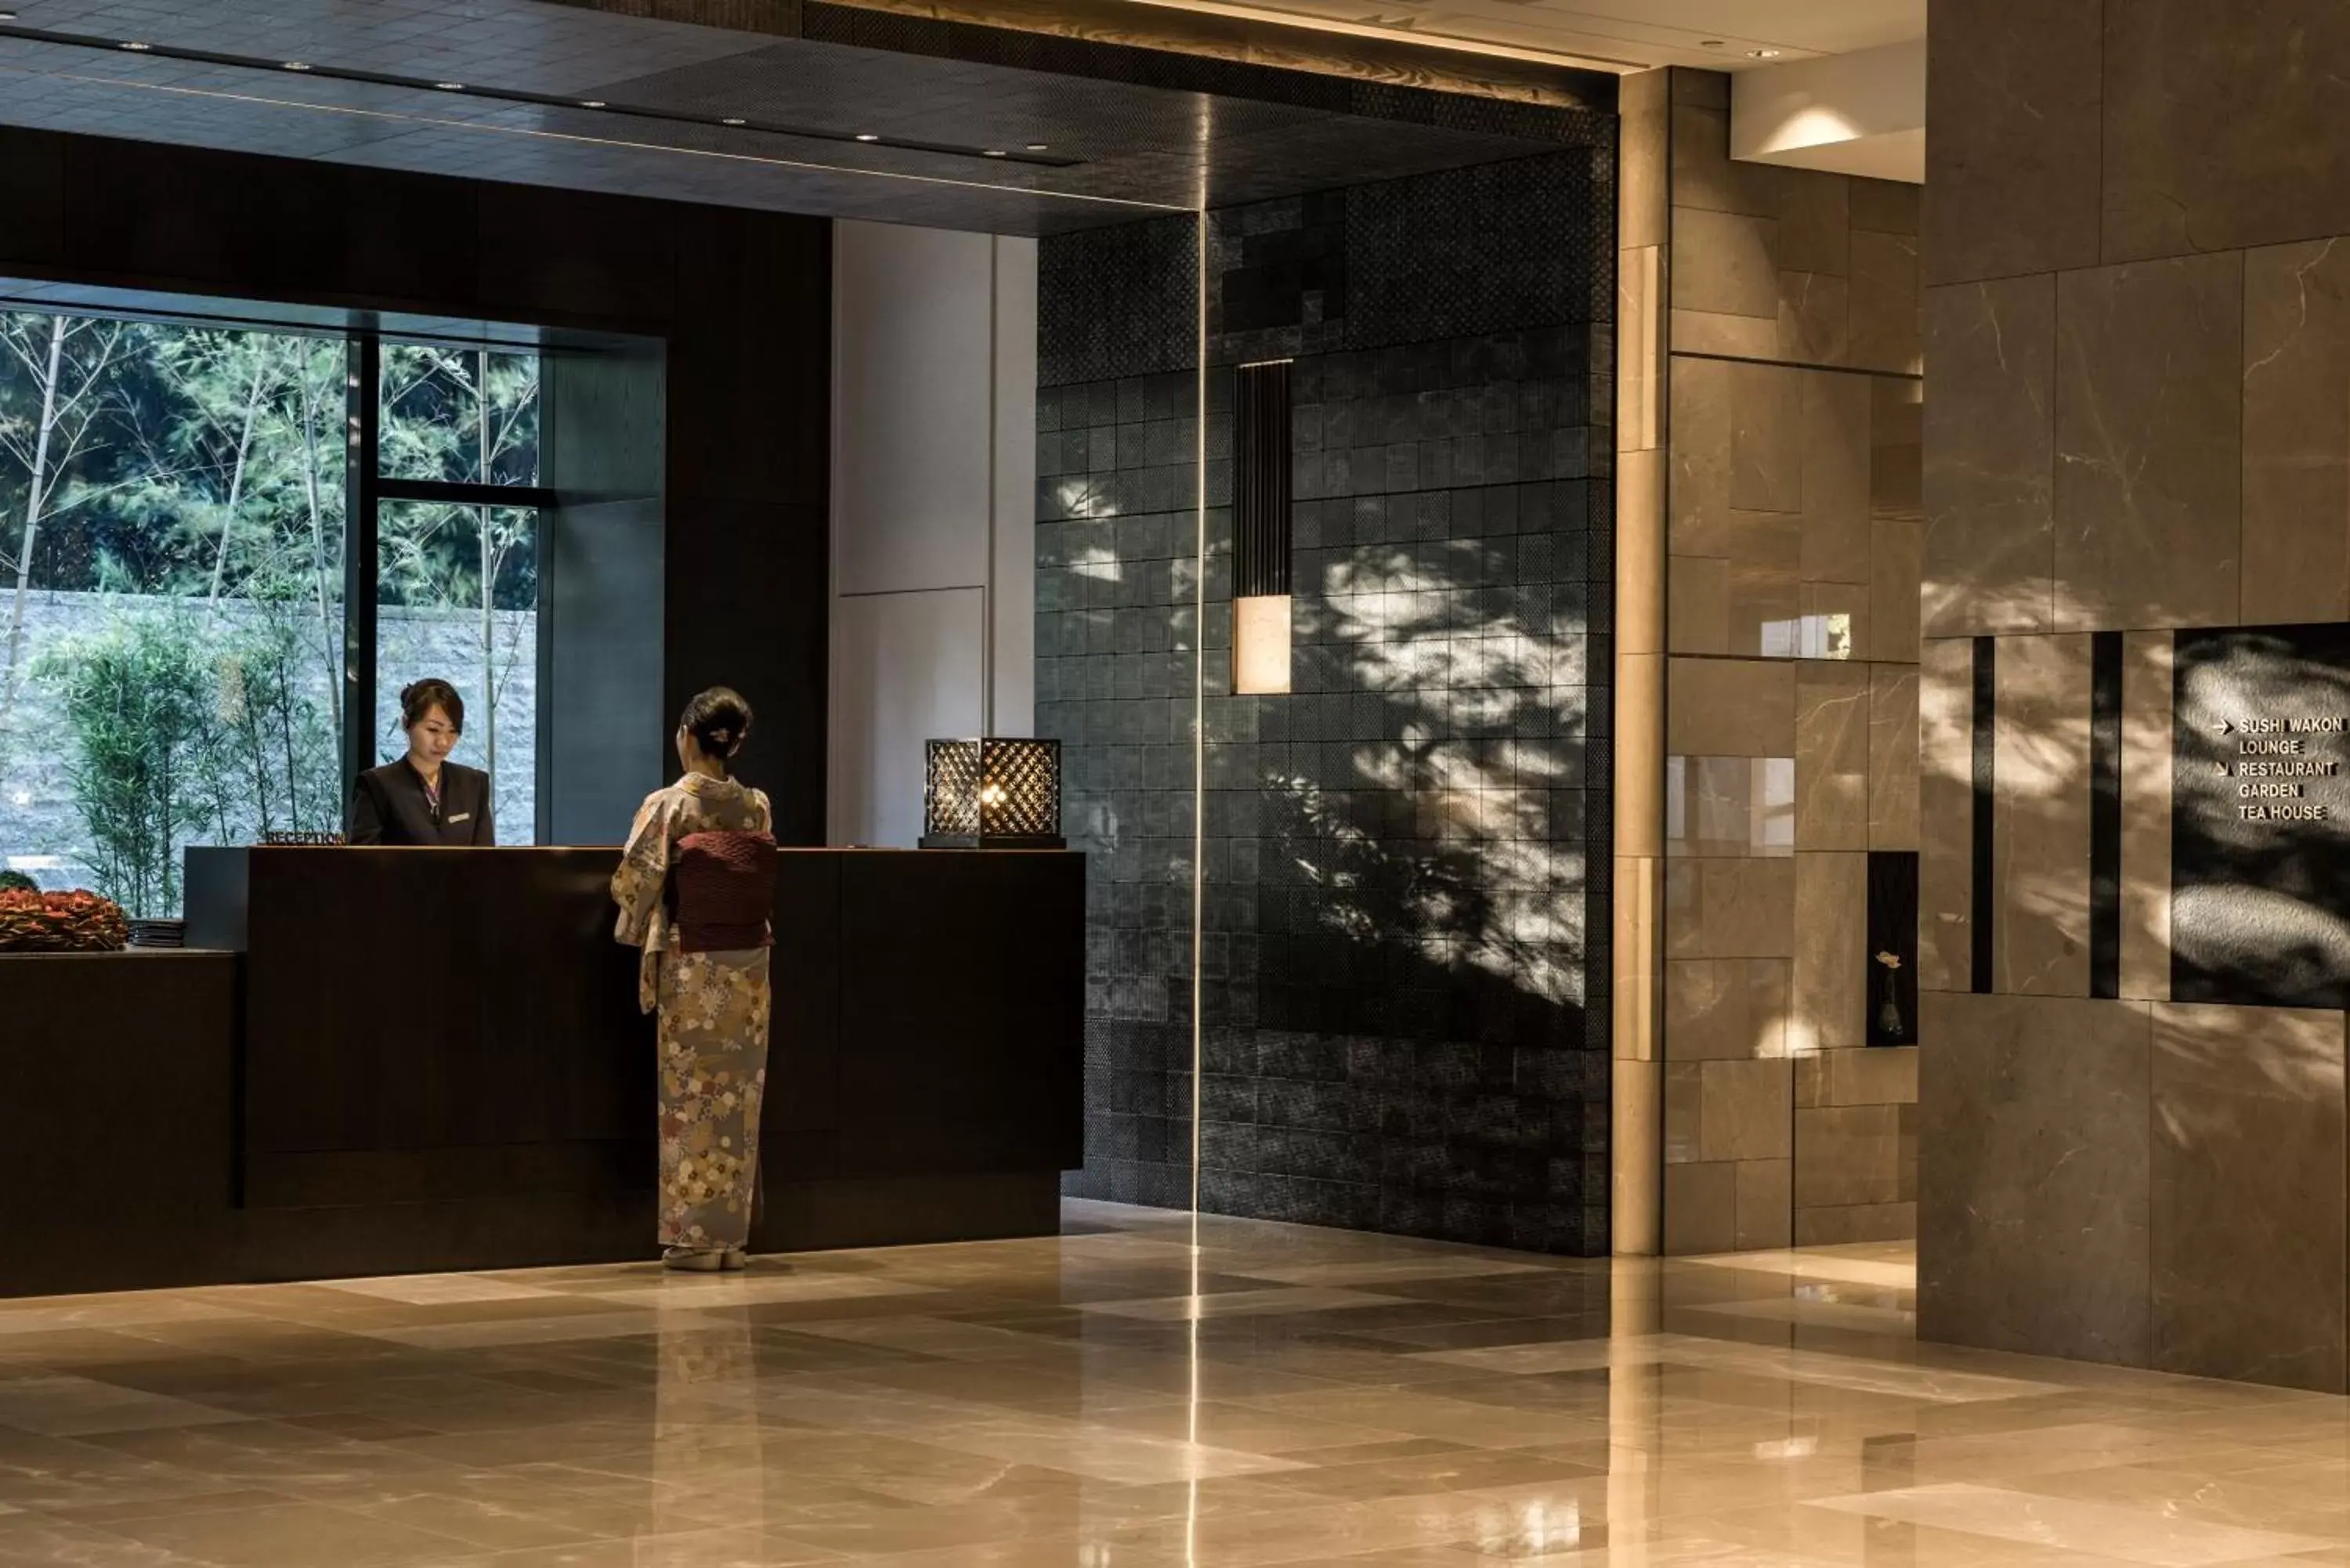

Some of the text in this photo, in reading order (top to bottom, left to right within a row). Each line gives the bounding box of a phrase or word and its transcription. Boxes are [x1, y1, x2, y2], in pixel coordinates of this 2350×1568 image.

[2240, 717, 2342, 733] SUSHI WAKON
[2240, 740, 2299, 755] LOUNGE
[2240, 762, 2334, 776] RESTAURANT
[2239, 784, 2298, 798] GARDEN
[2239, 805, 2323, 820] TEA HOUSE
[266, 831, 346, 845] RECEPTION
